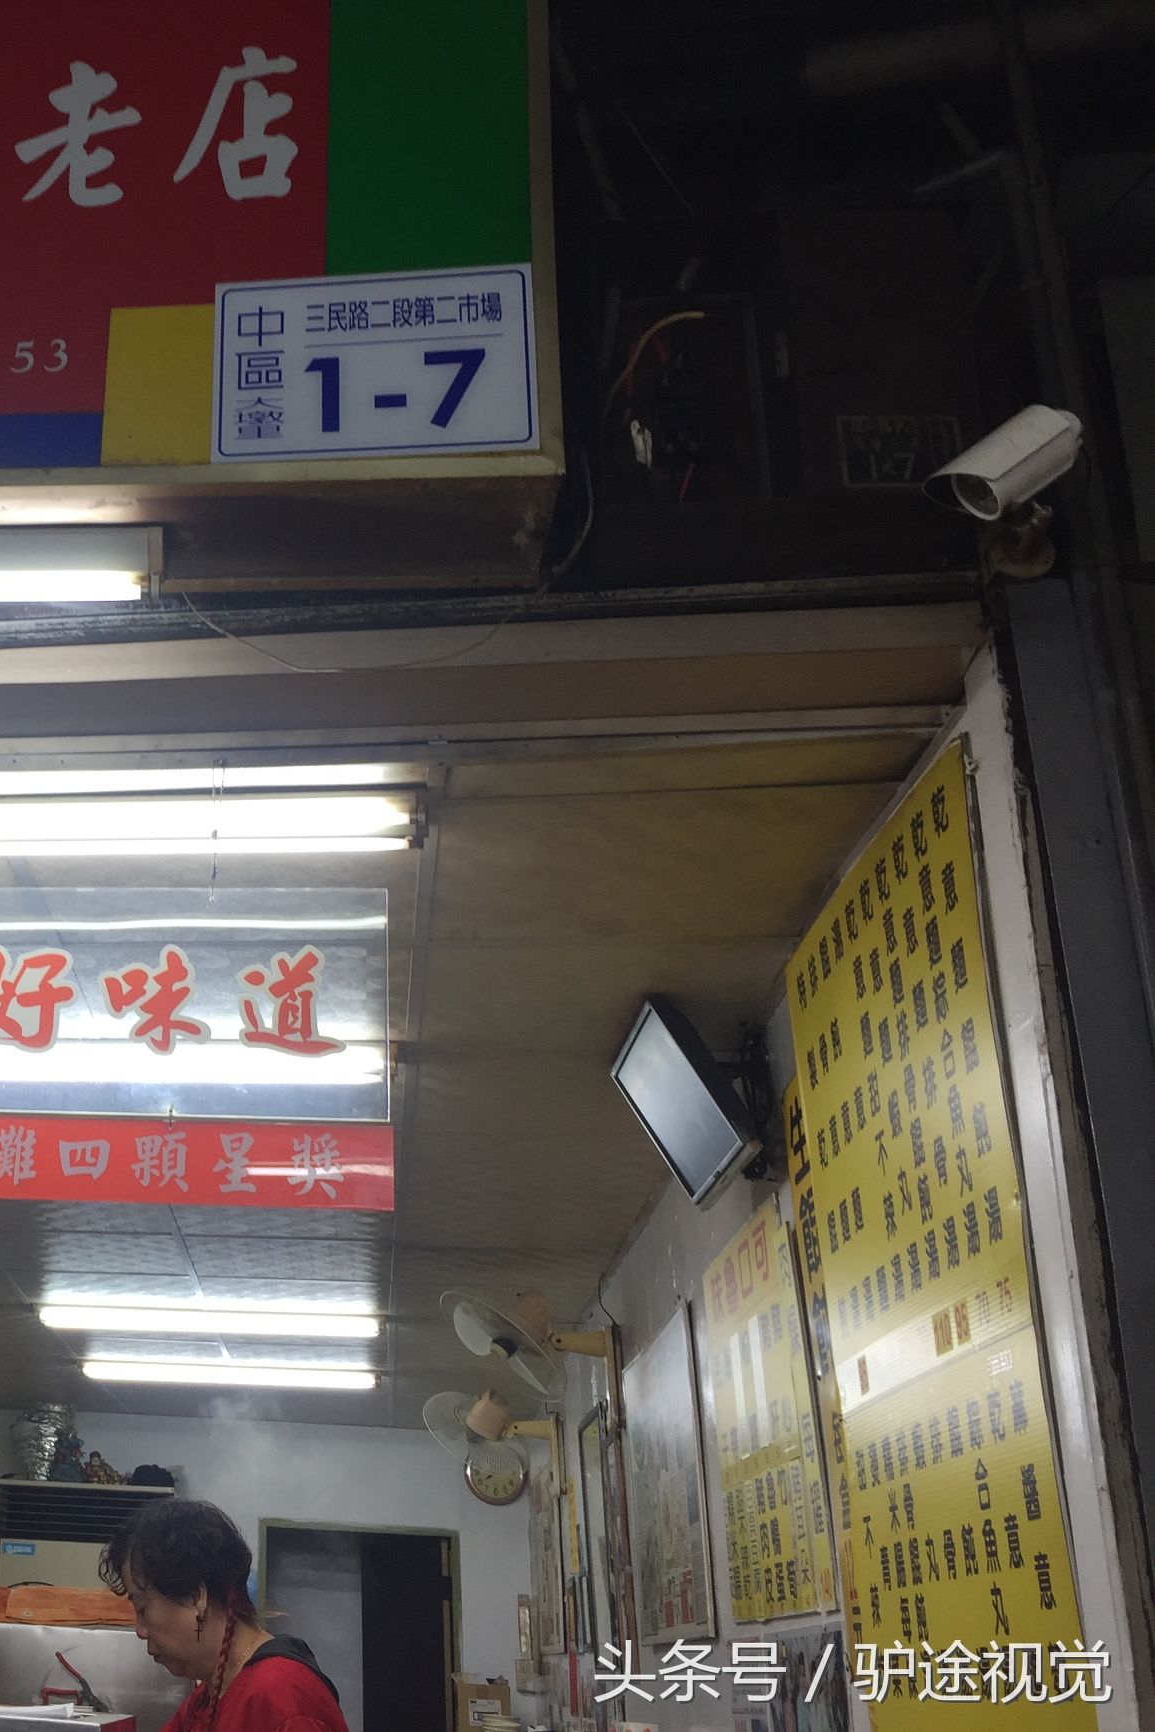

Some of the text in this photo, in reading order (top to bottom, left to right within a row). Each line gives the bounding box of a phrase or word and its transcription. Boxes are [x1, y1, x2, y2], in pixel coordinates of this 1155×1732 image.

[305, 291, 502, 332] 三民路二段第二市場
[304, 348, 486, 433] 1-7
